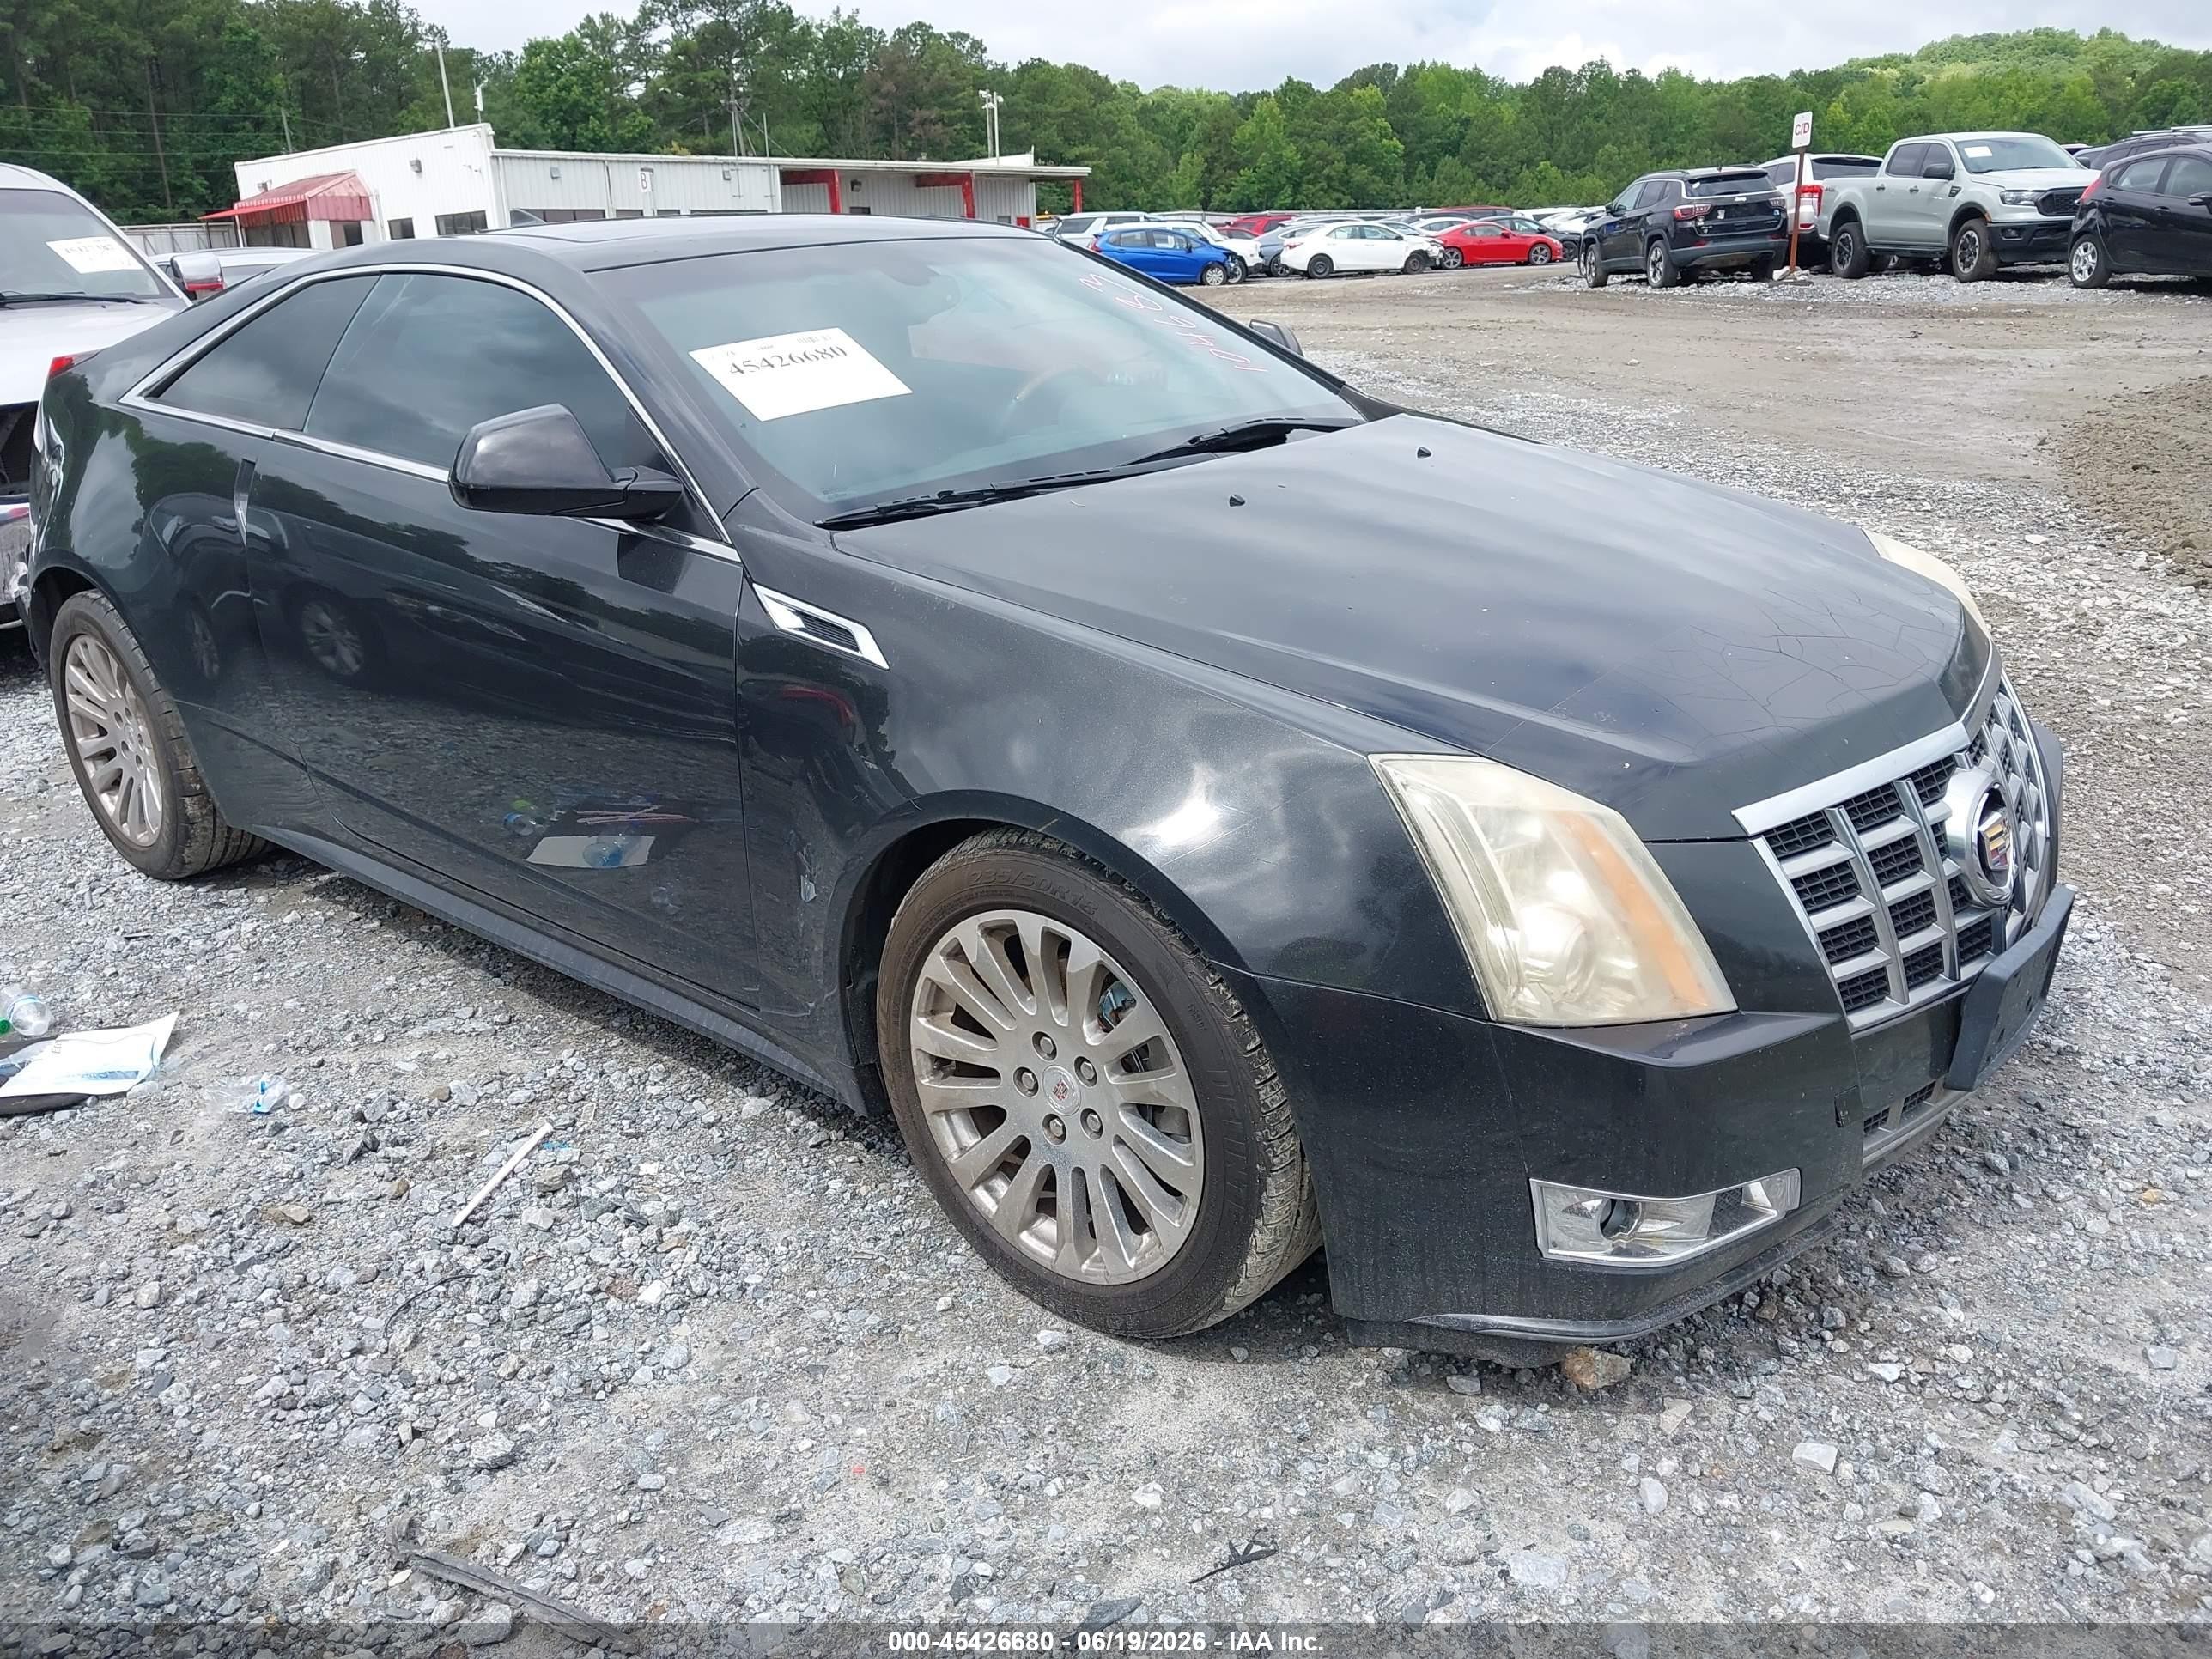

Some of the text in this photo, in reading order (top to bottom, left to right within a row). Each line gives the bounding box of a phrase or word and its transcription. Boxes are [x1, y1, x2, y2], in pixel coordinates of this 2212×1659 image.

[1794, 122, 1810, 137] C/D
[640, 172, 648, 190] B
[729, 344, 848, 375] 45426680
